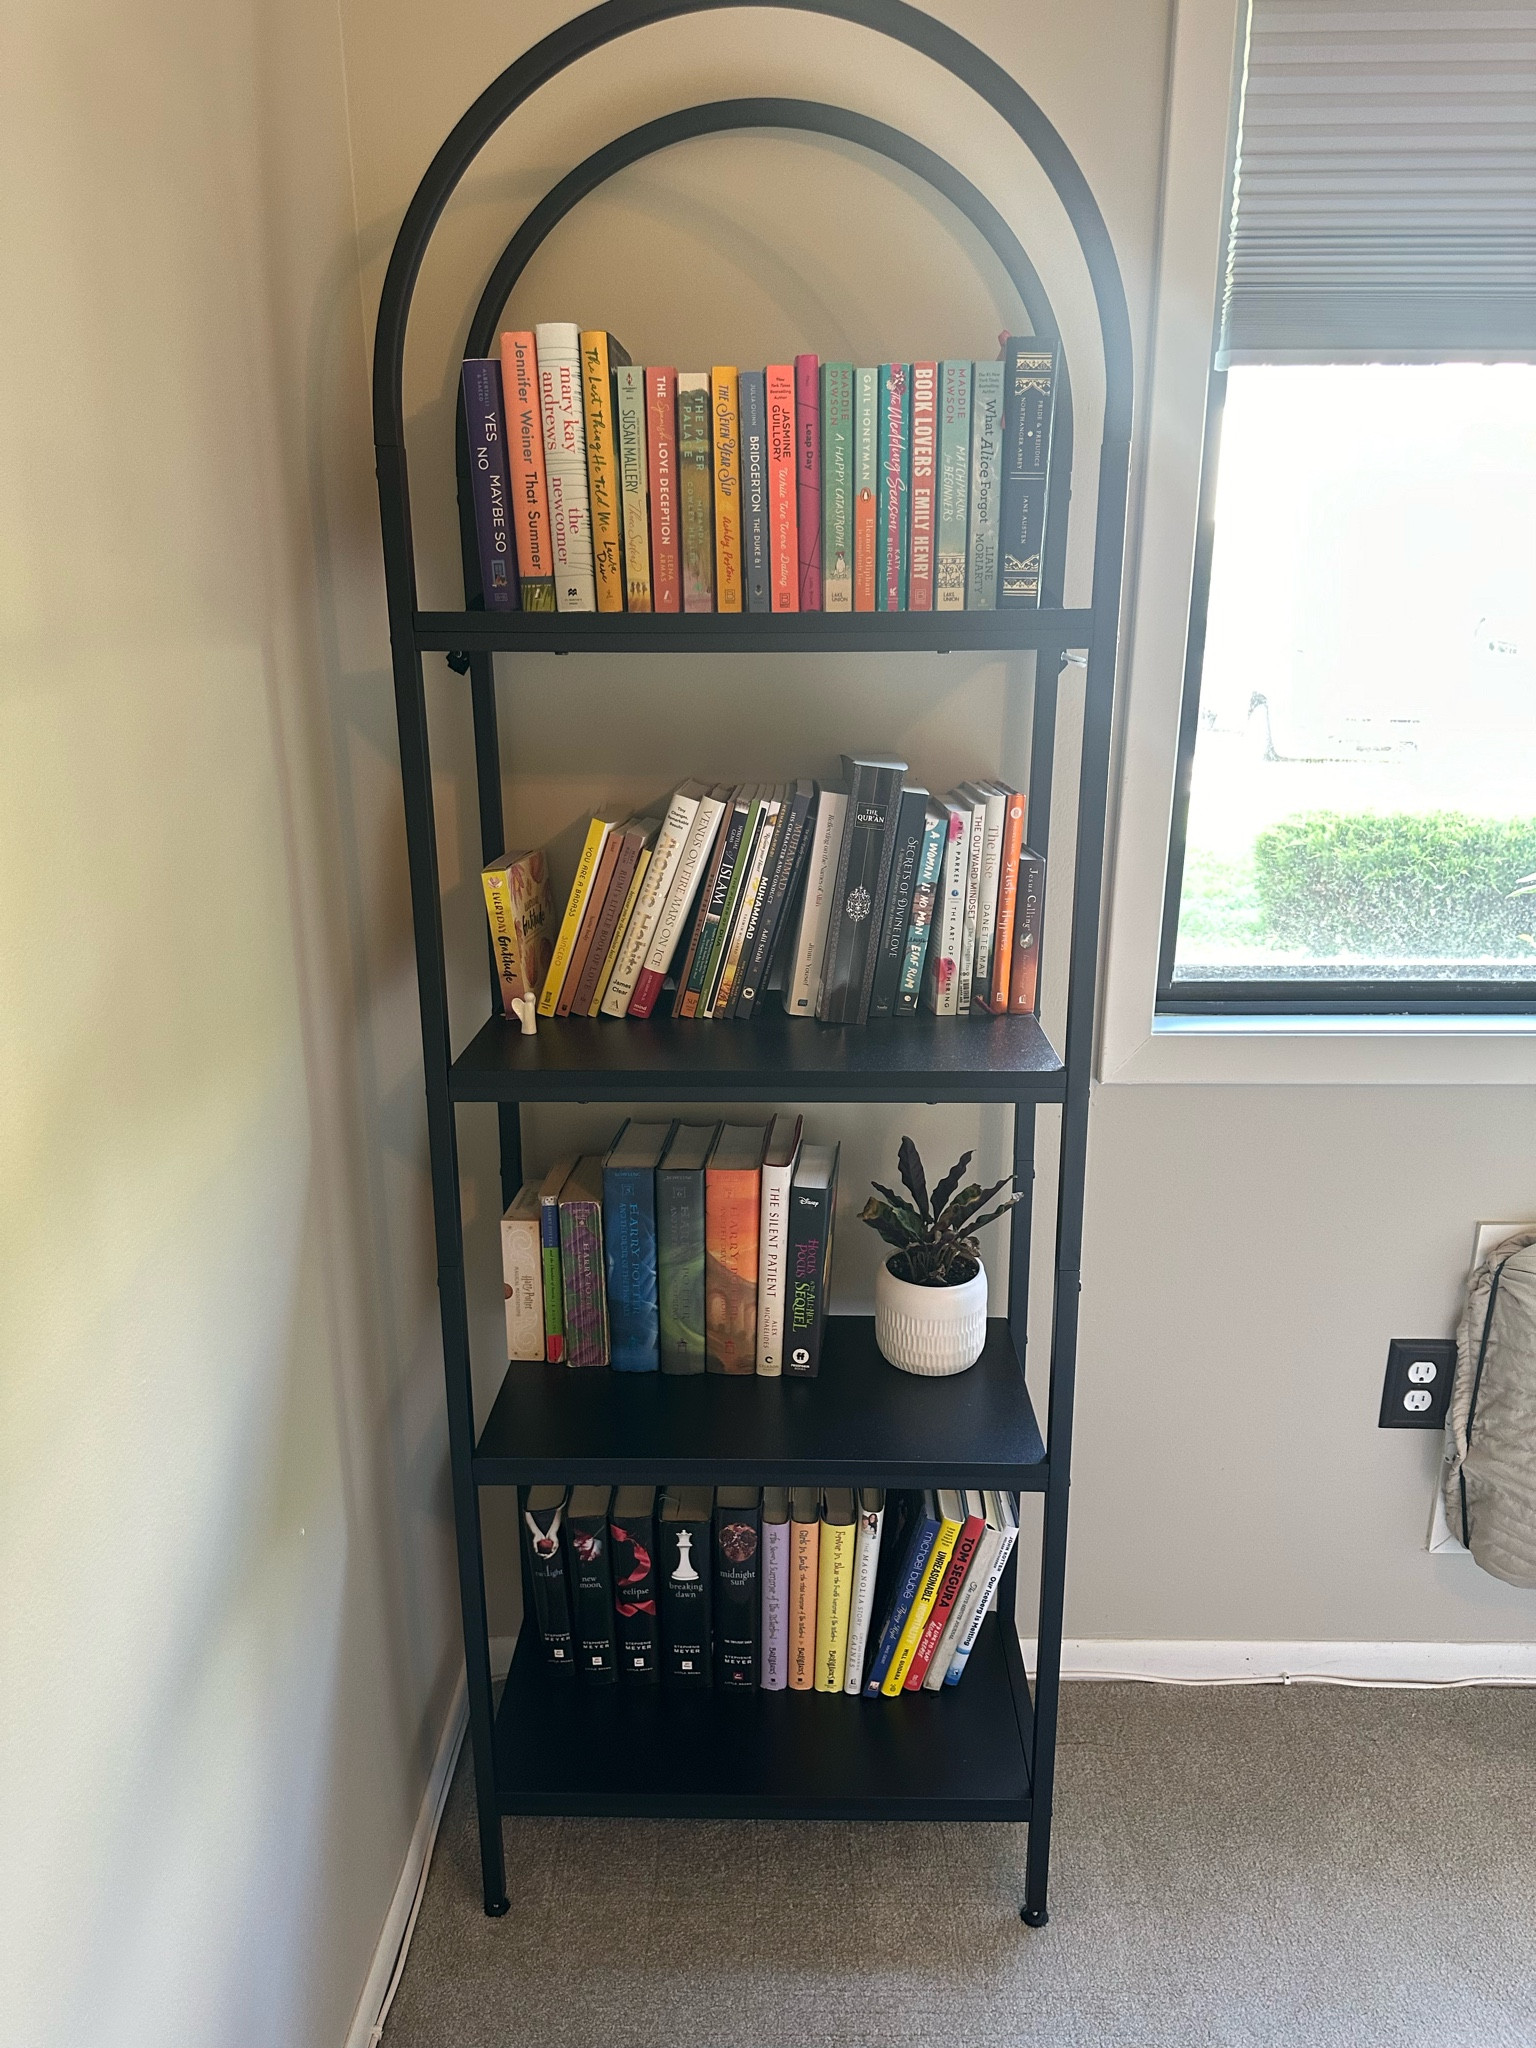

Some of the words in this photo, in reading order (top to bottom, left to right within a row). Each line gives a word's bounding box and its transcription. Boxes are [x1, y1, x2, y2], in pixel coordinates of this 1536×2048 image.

[514, 342, 530, 403] Jennifer
[585, 347, 600, 374] The
[558, 367, 574, 416] mary
[589, 377, 602, 405] Last
[656, 376, 666, 398] THE
[830, 370, 838, 426] DAWSON
[841, 370, 850, 421] MADDIE
[862, 375, 872, 404] GAIL
[890, 391, 901, 405] The
[915, 369, 934, 410] BOOK
[945, 368, 955, 425] DAWSON
[957, 368, 966, 419] MADDIE
[541, 371, 558, 452] andrews
[651, 400, 669, 441] Spanish
[695, 396, 705, 423] THE
[750, 404, 758, 426] QUINN
[984, 399, 997, 437] What
[485, 412, 497, 442] YES
[521, 410, 534, 464] Weiner
[562, 420, 579, 455] kay
[589, 410, 605, 453] Thing
[622, 410, 637, 447] SUSAN
[683, 405, 693, 459] PALACE
[771, 405, 782, 463] GUILLORY
[782, 408, 791, 459] JASMINE
[803, 424, 814, 449] Leap
[835, 433, 844, 442] A
[884, 406, 904, 475] Wedding
[476, 447, 489, 471] NO
[657, 443, 669, 475] LOVE
[695, 429, 705, 471] PAPER
[804, 451, 814, 471] Day
[862, 409, 872, 481] HONEYMAN
[914, 417, 933, 478] LOVERS
[980, 437, 997, 479] Alice
[593, 455, 607, 473] He
[624, 448, 638, 494] MALLERY
[749, 436, 761, 512] BRIDGERTON
[835, 446, 845, 484] HAPPY
[525, 472, 538, 504] That
[594, 478, 609, 508] Told
[955, 445, 966, 521] MATCHMAKING
[490, 475, 504, 528] MAYBE
[658, 478, 671, 545] DECEPTION
[887, 477, 904, 534] Season
[914, 489, 932, 531] EMILY
[978, 481, 991, 524] Forgot
[1021, 495, 1030, 514] JANE
[552, 477, 570, 565] newcomer
[568, 508, 584, 534] the
[598, 512, 610, 533] Me
[834, 488, 845, 548] CATASTROPHE
[1020, 516, 1029, 545] AUSTEN
[495, 532, 507, 553] SO
[528, 511, 542, 570] Summer
[659, 553, 667, 583] ARMAS
[886, 537, 894, 582] BIRCHALL
[913, 536, 931, 580] HENRY
[975, 533, 985, 595] MORIARTY
[985, 546, 994, 581] LIANE
[789, 811, 797, 822] HIS
[857, 813, 885, 824] QUR'AN
[865, 808, 879, 817] THE
[973, 816, 983, 833] THE
[692, 810, 713, 848] VENUS
[779, 823, 794, 859] CHARACTER
[930, 831, 940, 839] A
[954, 821, 964, 849] PRIYA
[987, 824, 1000, 850] The
[686, 849, 698, 869] ON
[775, 860, 784, 874] AND
[778, 823, 803, 891] MUHAMMAD
[901, 836, 919, 881] SECRETS
[922, 842, 939, 880] WOMAN
[953, 852, 961, 884] PARKER
[969, 835, 981, 880] OUTWARD
[984, 852, 998, 879] Rise
[676, 870, 691, 894] FIRE
[766, 875, 780, 904] CONDUCT
[899, 882, 910, 896] OF
[920, 882, 931, 893] IS
[1027, 867, 1040, 893] Jesus
[491, 892, 507, 934] EVERYDAY
[665, 895, 683, 928] MARS
[746, 876, 769, 939] MUHAMMAD
[892, 897, 910, 932] DIVINE
[918, 895, 929, 908] NO
[949, 906, 957, 922] THE
[967, 882, 979, 920] MINDSET
[1024, 895, 1038, 929] Calling
[659, 929, 673, 949] ON
[760, 929, 769, 942] Adil
[914, 911, 927, 935] MAN
[948, 924, 956, 942] ART
[980, 903, 992, 951] DANETTE
[497, 935, 518, 985] Gratitude
[650, 949, 667, 967] ICE
[755, 944, 765, 963] Salahi
[888, 934, 901, 959] LOVE
[908, 945, 921, 966] ETAF
[947, 945, 955, 957] OF
[904, 967, 919, 989] RUM
[978, 955, 987, 976] MAY
[612, 978, 632, 990] James
[612, 986, 628, 996] Clear
[943, 959, 954, 1009] GATHERING
[769, 1188, 780, 1207] THE
[799, 1195, 820, 1207] Disney
[629, 1203, 641, 1257] HARRY
[768, 1212, 780, 1249] SILENT
[795, 1244, 808, 1278] POCUS
[807, 1239, 819, 1274] HOCUS
[521, 1275, 534, 1291] Harry
[631, 1262, 641, 1315] POTTER
[766, 1253, 778, 1298] PATIENT
[523, 1291, 535, 1309] Potter
[792, 1281, 810, 1332] SEQUEL
[763, 1306, 771, 1349] MICHAELIDES
[912, 1531, 936, 1571] michael
[957, 1537, 976, 1562] TOM
[1005, 1536, 1014, 1551] JOHN
[720, 1568, 756, 1579] midnight
[920, 1550, 948, 1602] UNREASONABLE
[997, 1551, 1009, 1571] KOTTER
[622, 1587, 650, 1599] eclipse
[668, 1582, 703, 1592] breaking
[903, 1571, 922, 1599] bublé
[939, 1564, 966, 1608] SEGURA
[892, 1603, 909, 1623] Flying
[889, 1623, 902, 1639] High
[849, 1634, 858, 1668] GAINES
[903, 1648, 913, 1660] WILL
[893, 1660, 909, 1681] GUIDARA
